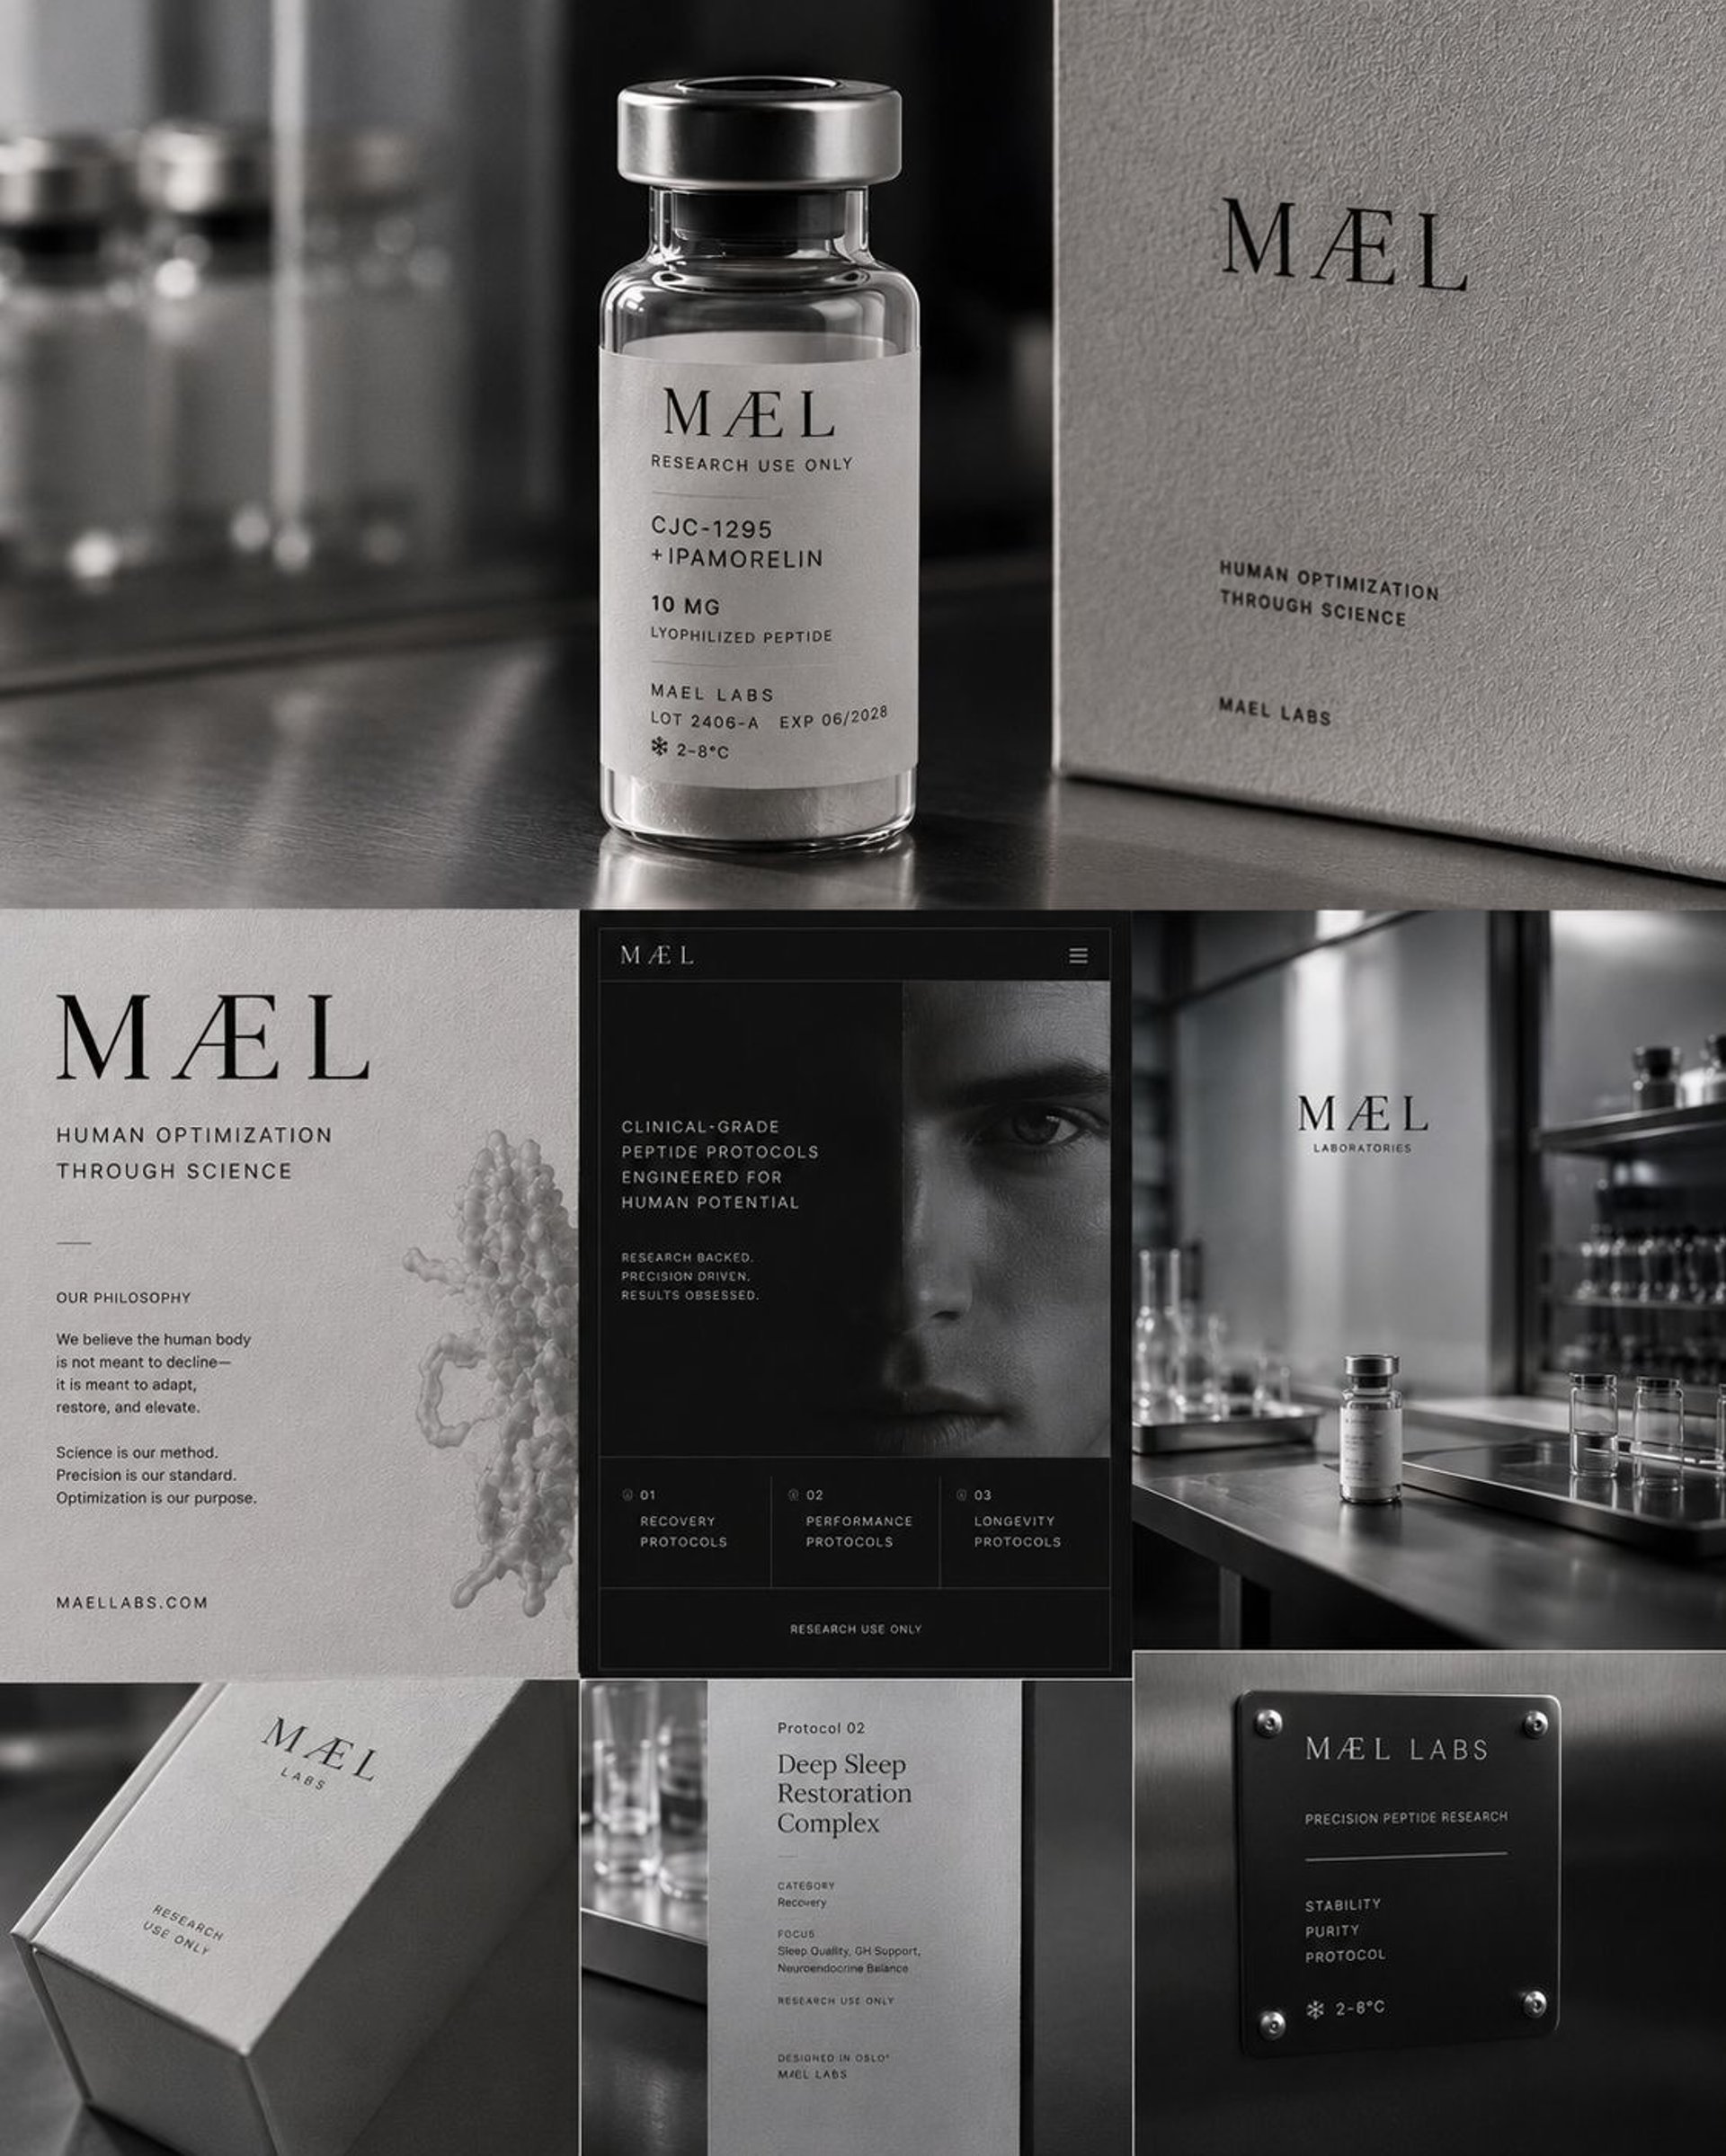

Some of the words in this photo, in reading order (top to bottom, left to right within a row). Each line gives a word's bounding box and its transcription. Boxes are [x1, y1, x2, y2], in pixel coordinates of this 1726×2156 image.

[1222, 197, 1468, 292] MÆL
[663, 387, 835, 438] MÆL
[651, 454, 749, 473] RESEARCH
[758, 457, 796, 473] USE
[805, 457, 853, 472] ONLY
[651, 516, 772, 539] CJC-1295
[1219, 561, 1288, 582] HUMAN
[1297, 570, 1439, 601] OPTIMIZATION
[651, 595, 675, 613] 10
[684, 597, 720, 616] MG
[1221, 590, 1312, 615] THROUGH
[1321, 603, 1406, 626] SCIENCE
[651, 626, 756, 644] LYOPHILIZED
[763, 629, 833, 644] PEPTIDE
[651, 683, 705, 701] MAEL
[717, 687, 774, 703] LABS
[651, 712, 682, 727] LOT
[691, 714, 760, 730] 2406-A
[779, 714, 814, 730] EXP
[821, 705, 888, 727] 06/2028
[1219, 697, 1270, 718] MAEL
[1280, 706, 1331, 726] LABS
[620, 945, 695, 965] MÆL
[57, 994, 369, 1079] MÆL
[1298, 1096, 1428, 1131] MÆL
[621, 1120, 779, 1133] CLINICAL-GRADE
[57, 1127, 145, 1143] HUMAN
[156, 1127, 332, 1143] OPTIMIZATION
[621, 1145, 699, 1159] PEPTIDE
[707, 1145, 819, 1159] PROTOCOLS
[1314, 1144, 1411, 1153] LABORATORIES
[57, 1163, 174, 1179] THROUGH
[187, 1163, 291, 1179] SCIENCE
[621, 1170, 739, 1184] ENGINEERED
[747, 1170, 782, 1184] FOR
[621, 1196, 689, 1209] HUMAN
[698, 1196, 799, 1209] POTENTIAL
[621, 1253, 692, 1263] RESEARCH
[698, 1253, 754, 1263] BACKED.
[621, 1272, 693, 1282] PRECISION
[698, 1272, 751, 1282] DRIVEN.
[56, 1292, 88, 1304] OUR
[93, 1292, 191, 1304] PHILOSOPHY
[621, 1291, 680, 1300] RESULTS
[685, 1291, 760, 1300] OBSESSED.
[56, 1334, 79, 1345] We
[83, 1333, 133, 1346] believe
[137, 1334, 160, 1345] the
[164, 1334, 211, 1346] human
[216, 1334, 251, 1349] body
[56, 1356, 67, 1368] is
[72, 1356, 95, 1368] not
[100, 1357, 144, 1368] meant
[148, 1357, 162, 1368] to
[56, 1379, 65, 1391] it
[70, 1379, 81, 1391] is
[85, 1380, 129, 1391] meant
[134, 1380, 147, 1391] to
[152, 1379, 197, 1394] adapt,
[56, 1402, 110, 1415] restore,
[115, 1401, 140, 1414] and
[145, 1401, 200, 1414] elevate.
[56, 1446, 112, 1460] Science
[117, 1446, 128, 1460] is
[133, 1448, 156, 1460] our
[160, 1446, 218, 1460] method.
[56, 1468, 121, 1482] Precision
[126, 1468, 137, 1482] is
[142, 1470, 165, 1482] our
[169, 1468, 236, 1482] standard.
[56, 1491, 146, 1507] Optimization
[151, 1491, 163, 1504] is
[167, 1494, 190, 1504] our
[194, 1494, 257, 1507] purpose.
[640, 1490, 656, 1501] 01
[806, 1490, 823, 1501] 02
[974, 1490, 992, 1501] 03
[641, 1516, 716, 1527] RECOVERY
[806, 1516, 913, 1527] PERFORMANCE
[974, 1516, 1055, 1527] LONGEVITY
[641, 1537, 727, 1548] PROTOCOLS
[806, 1537, 894, 1548] PROTOCOLS
[974, 1537, 1061, 1548] PROTOCOLS
[56, 1596, 208, 1610] MAELLABS.COM
[790, 1624, 857, 1635] RESEARCH
[861, 1624, 885, 1635] USE
[890, 1624, 921, 1635] ONLY
[778, 1722, 841, 1735] Protocol
[848, 1722, 865, 1734] 02
[261, 1717, 378, 1782] MÆL
[1306, 1736, 1391, 1761] MÆL
[1410, 1738, 1489, 1761] LABS
[778, 1754, 837, 1780] Deep
[845, 1753, 906, 1779] Sleep
[280, 1768, 325, 1790] LABS
[778, 1783, 912, 1804] Restoration
[1306, 1814, 1379, 1825] PRECISION
[1383, 1812, 1437, 1823] PEPTIDE
[1441, 1810, 1508, 1823] RESEARCH
[778, 1812, 880, 1839] Complex
[778, 1898, 826, 1909] Recovery
[1306, 1899, 1381, 1912] STABILITY
[152, 1905, 224, 1941] RESEARCH
[143, 1921, 171, 1939] USE
[173, 1935, 210, 1956] ONLY
[778, 1930, 814, 1939] FOCUS
[1306, 1925, 1359, 1938] PURITY
[778, 1947, 806, 1956] Sleep
[1306, 1949, 1386, 1963] PROTOCOL
[840, 2054, 850, 2063] IN
[815, 2071, 847, 2080] LABS
